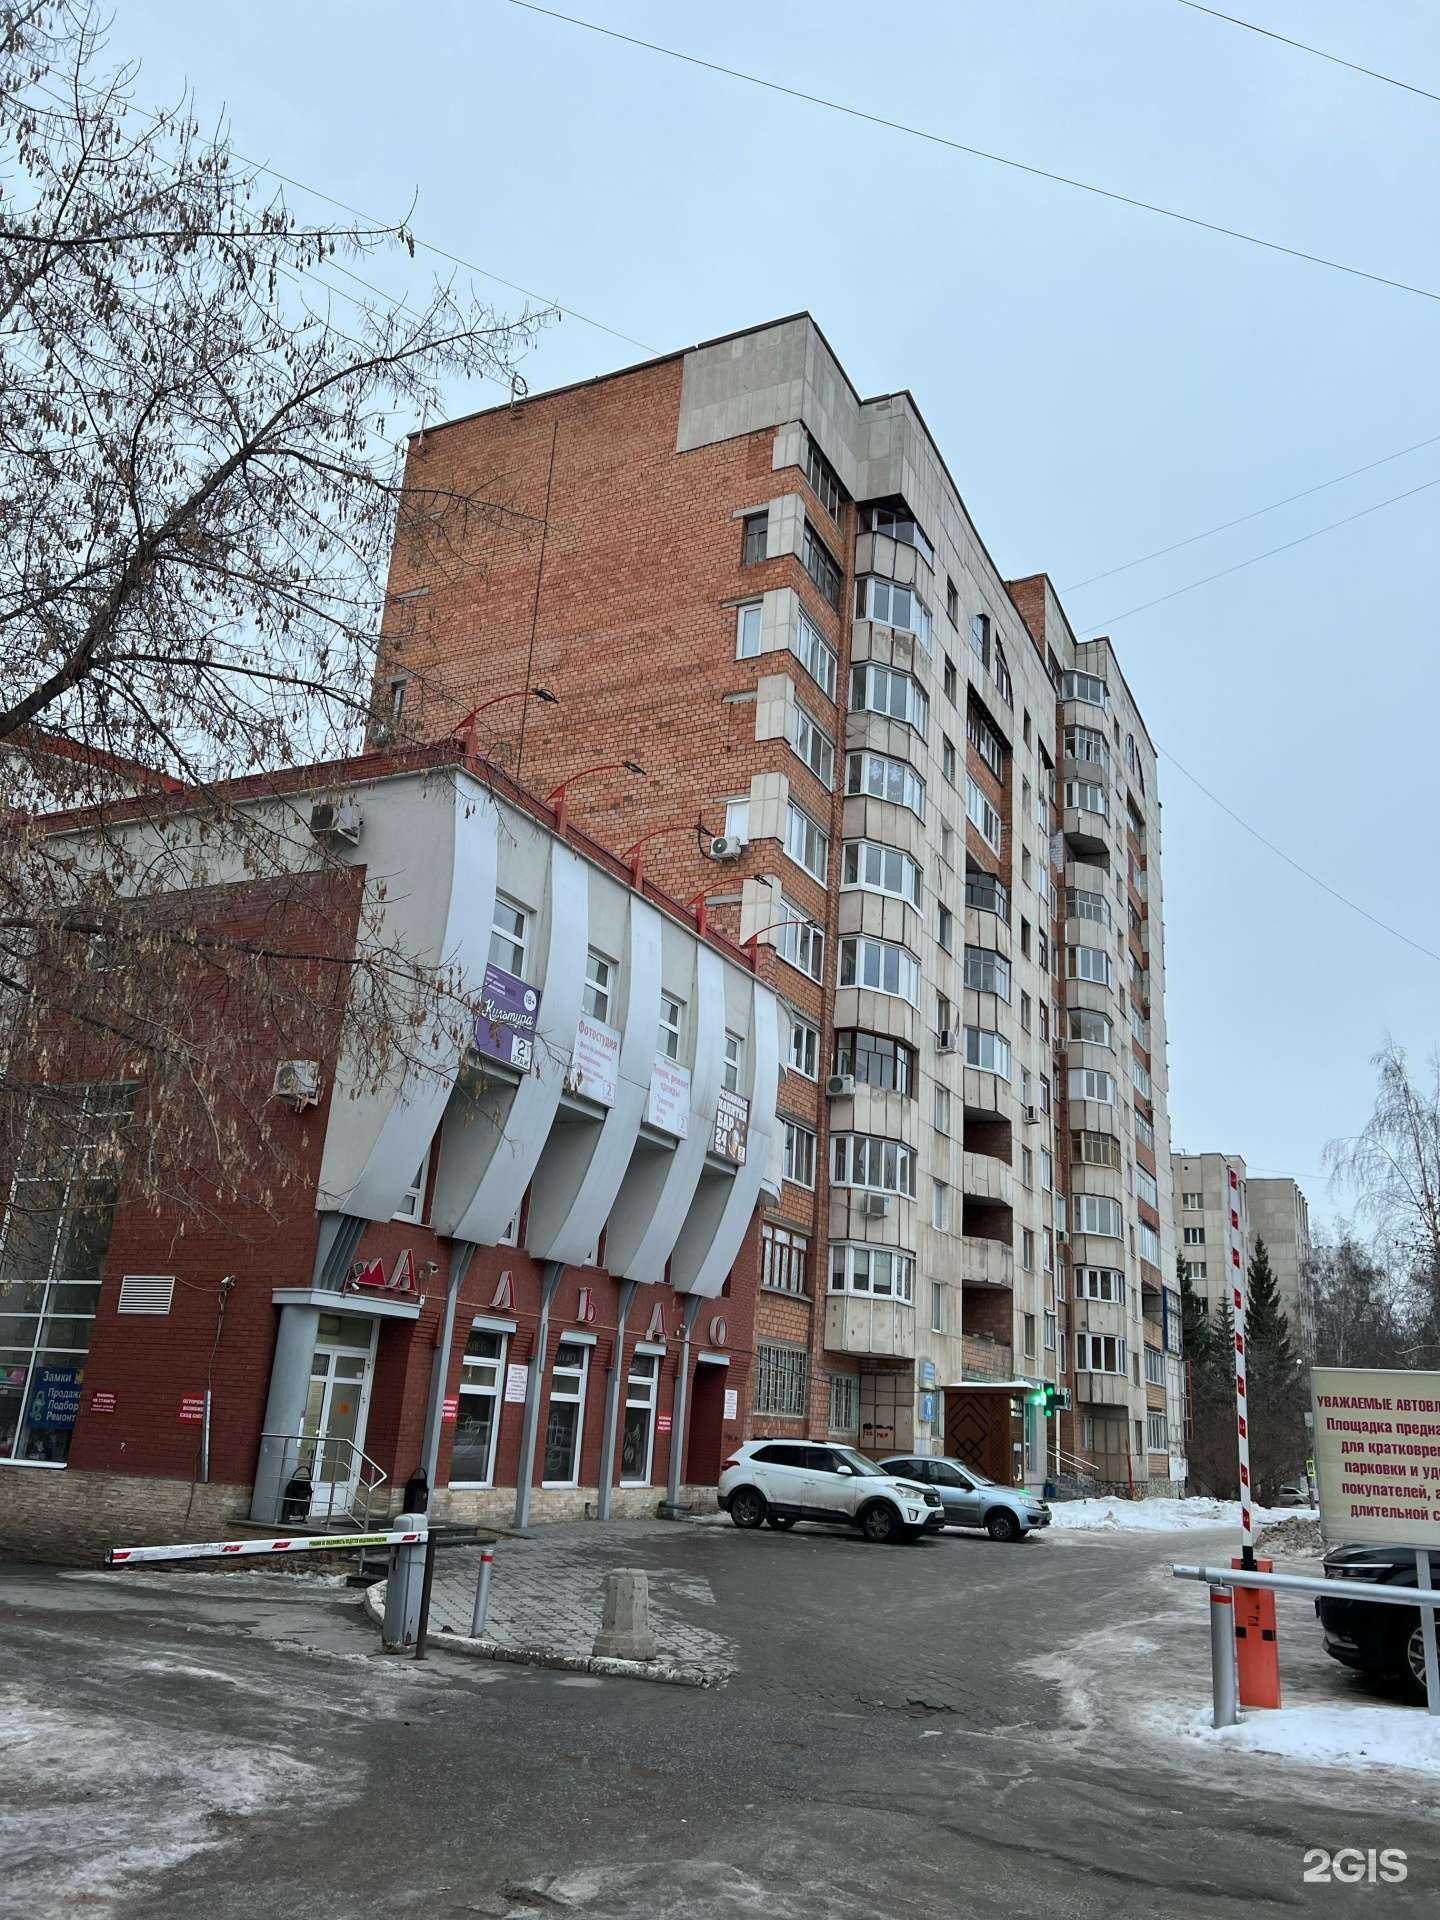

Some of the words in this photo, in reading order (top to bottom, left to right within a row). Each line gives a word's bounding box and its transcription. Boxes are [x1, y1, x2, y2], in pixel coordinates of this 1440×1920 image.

[481, 999, 534, 1028] Культура
[578, 1020, 618, 1050] Фотостудия
[518, 1040, 526, 1057] 2
[512, 1055, 529, 1067] ЭТАЖ
[716, 1110, 735, 1132] БАР
[715, 1127, 728, 1147] 24
[42, 1370, 72, 1383] Замки
[48, 1399, 79, 1412] Подбор
[1317, 1395, 1393, 1411] УВАЖАЕМЫЕ
[46, 1411, 77, 1422] Ремонт
[1326, 1417, 1392, 1434] Площадка
[1341, 1441, 1364, 1454] для
[1344, 1462, 1406, 1476] парковки
[1410, 1465, 1418, 1477] и
[1422, 1466, 1440, 1480] уд
[1342, 1482, 1431, 1501] покупателей,
[1351, 1504, 1429, 1521] длительной
